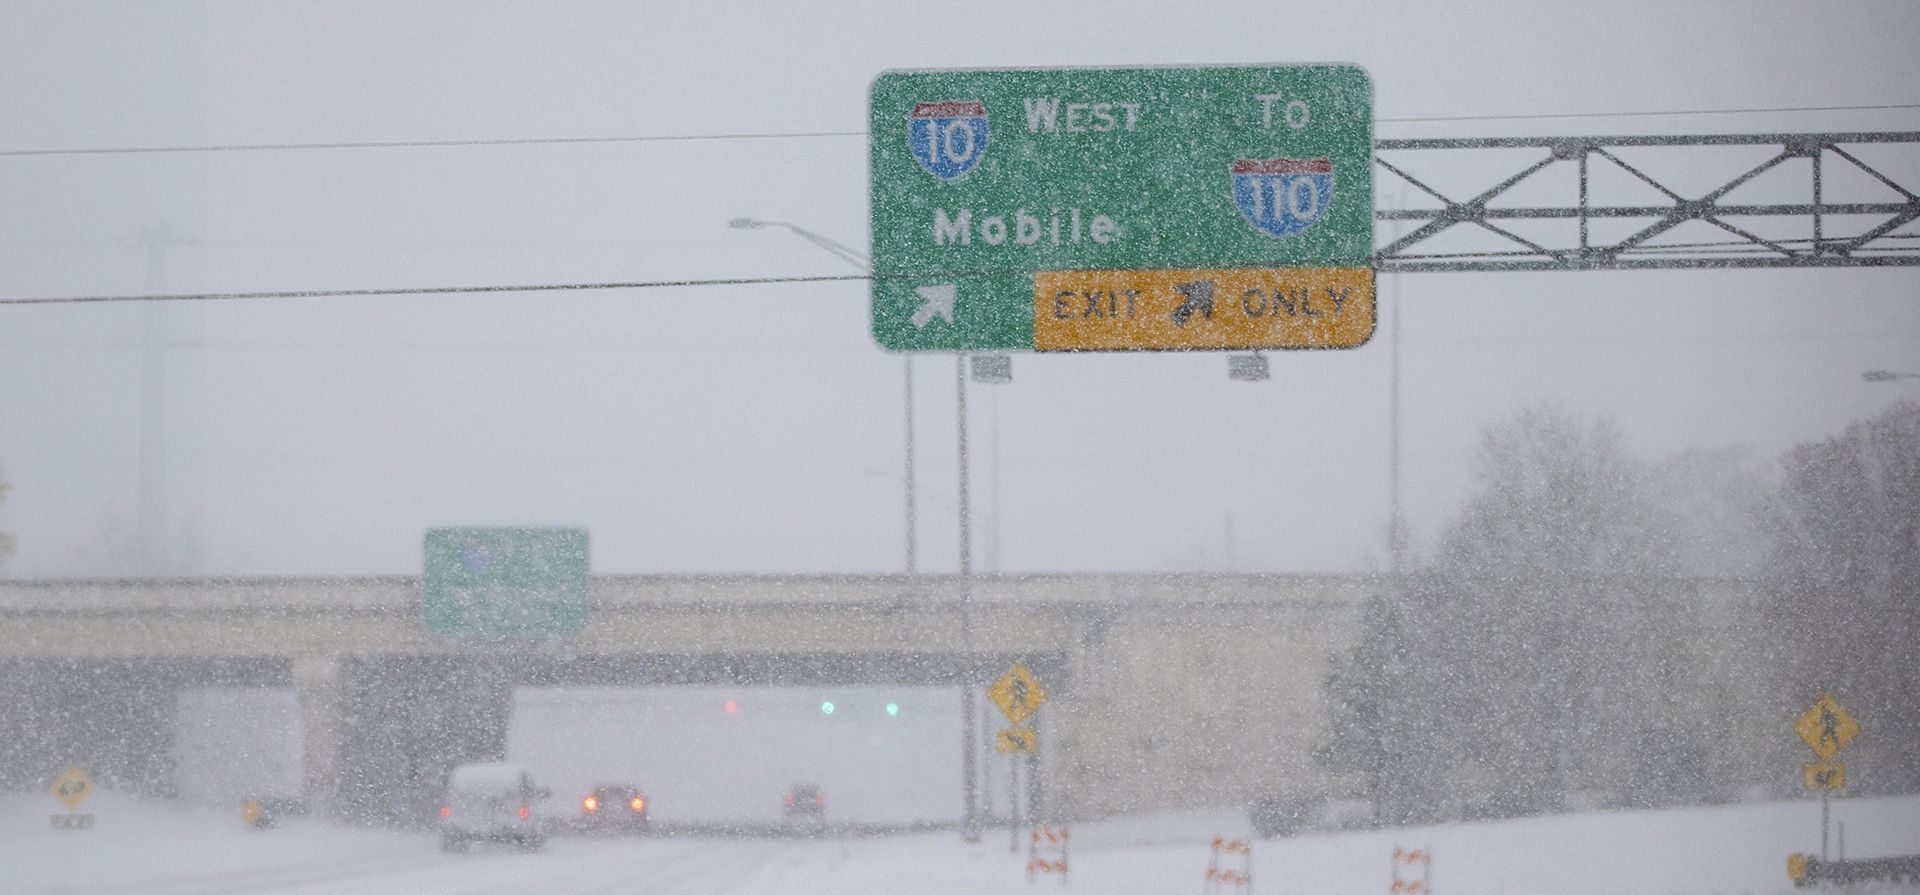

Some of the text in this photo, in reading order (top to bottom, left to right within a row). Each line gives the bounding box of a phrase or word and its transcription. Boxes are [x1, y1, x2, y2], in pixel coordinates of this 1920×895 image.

[1024, 98, 1142, 132] WEST
[926, 119, 975, 163] 10
[1251, 176, 1318, 221] 110
[934, 208, 1116, 246] Mobile
[1054, 286, 1352, 320] EXIT ONLY
